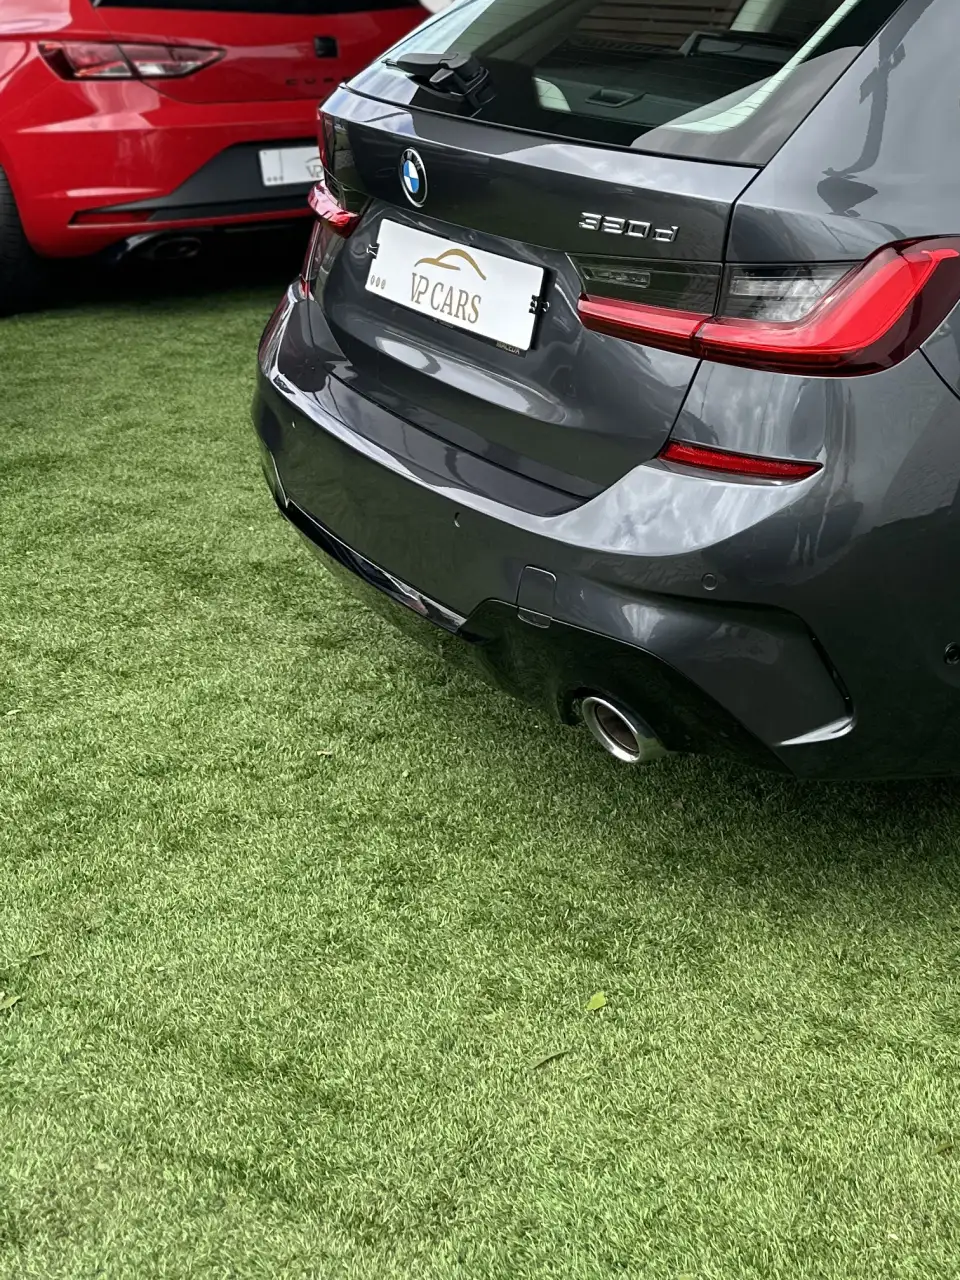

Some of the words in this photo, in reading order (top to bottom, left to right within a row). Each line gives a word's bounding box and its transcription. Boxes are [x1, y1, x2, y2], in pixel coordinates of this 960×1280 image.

[579, 212, 679, 243] 320d
[410, 272, 430, 305] VP
[430, 282, 482, 324] CARS
